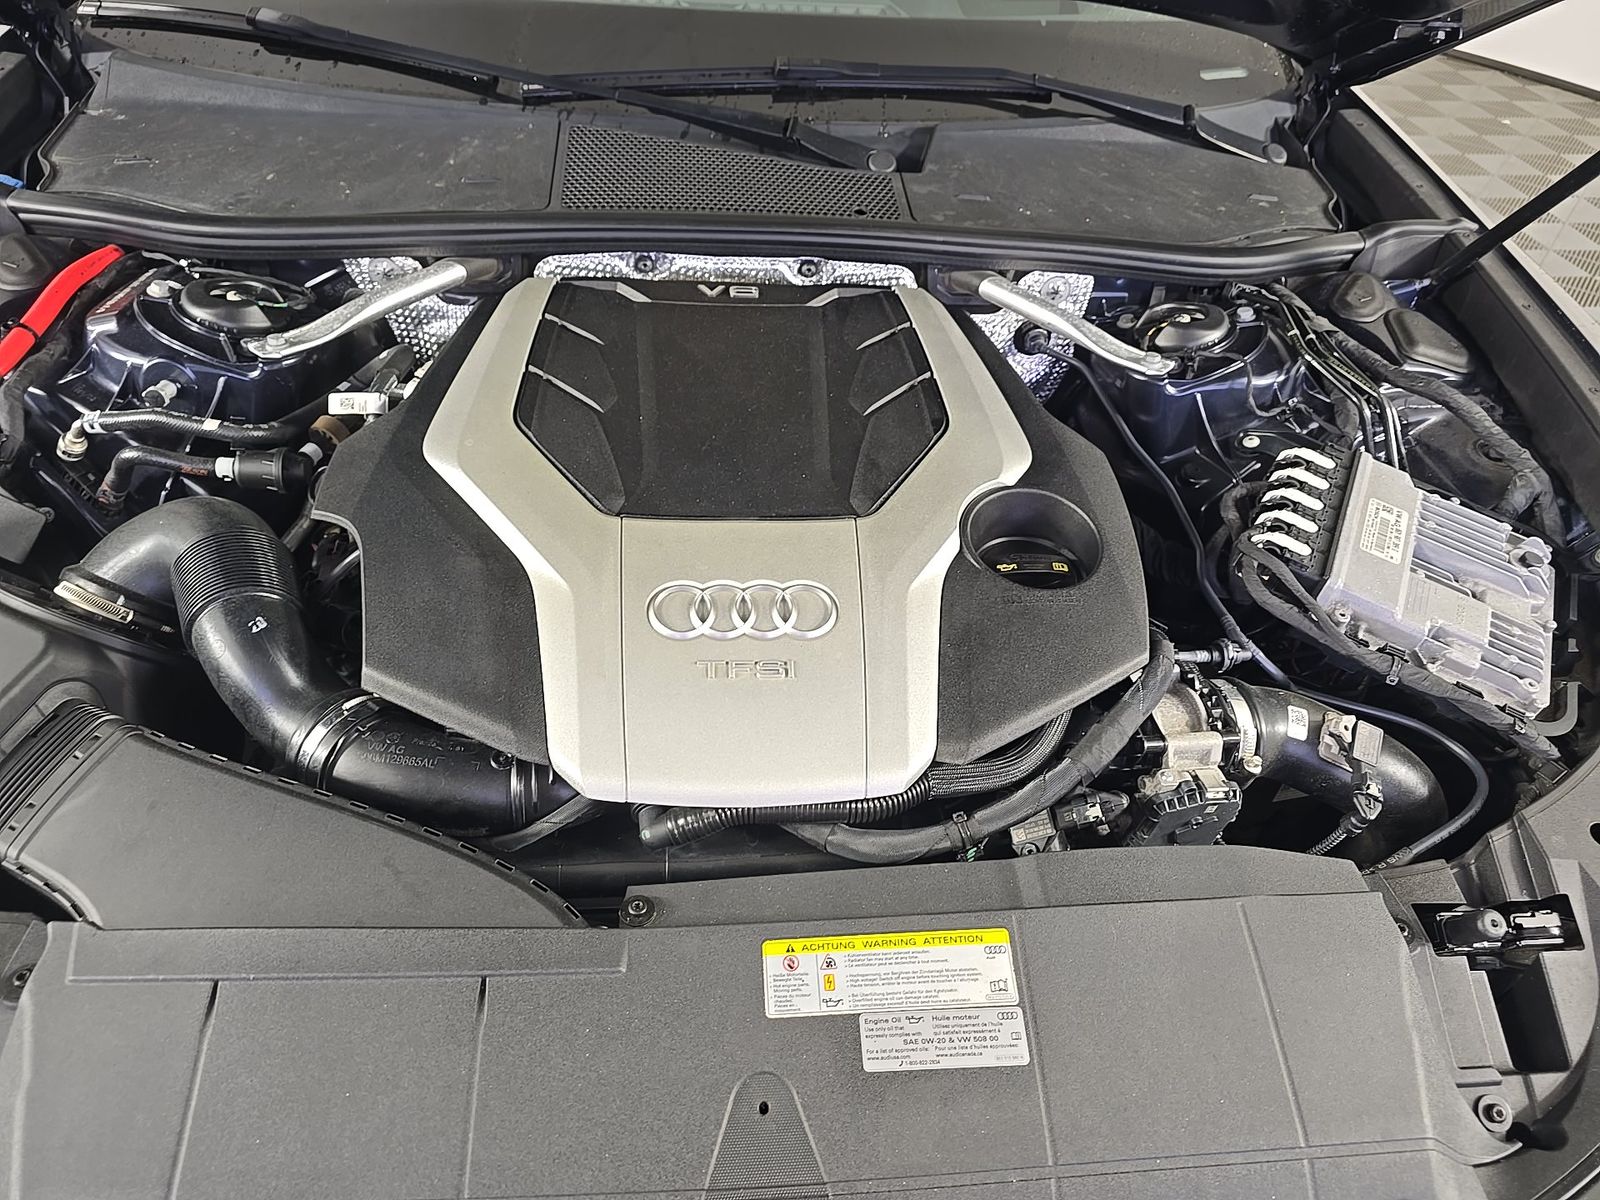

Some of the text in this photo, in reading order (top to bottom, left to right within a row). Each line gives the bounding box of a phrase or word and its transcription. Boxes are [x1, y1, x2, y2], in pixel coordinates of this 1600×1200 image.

[694, 660, 796, 680] TFSI
[367, 741, 388, 752] VW
[388, 744, 405, 754] AG
[801, 934, 983, 951] ACHTUNG WARNING ATTENTION
[864, 1017, 889, 1025] Engine
